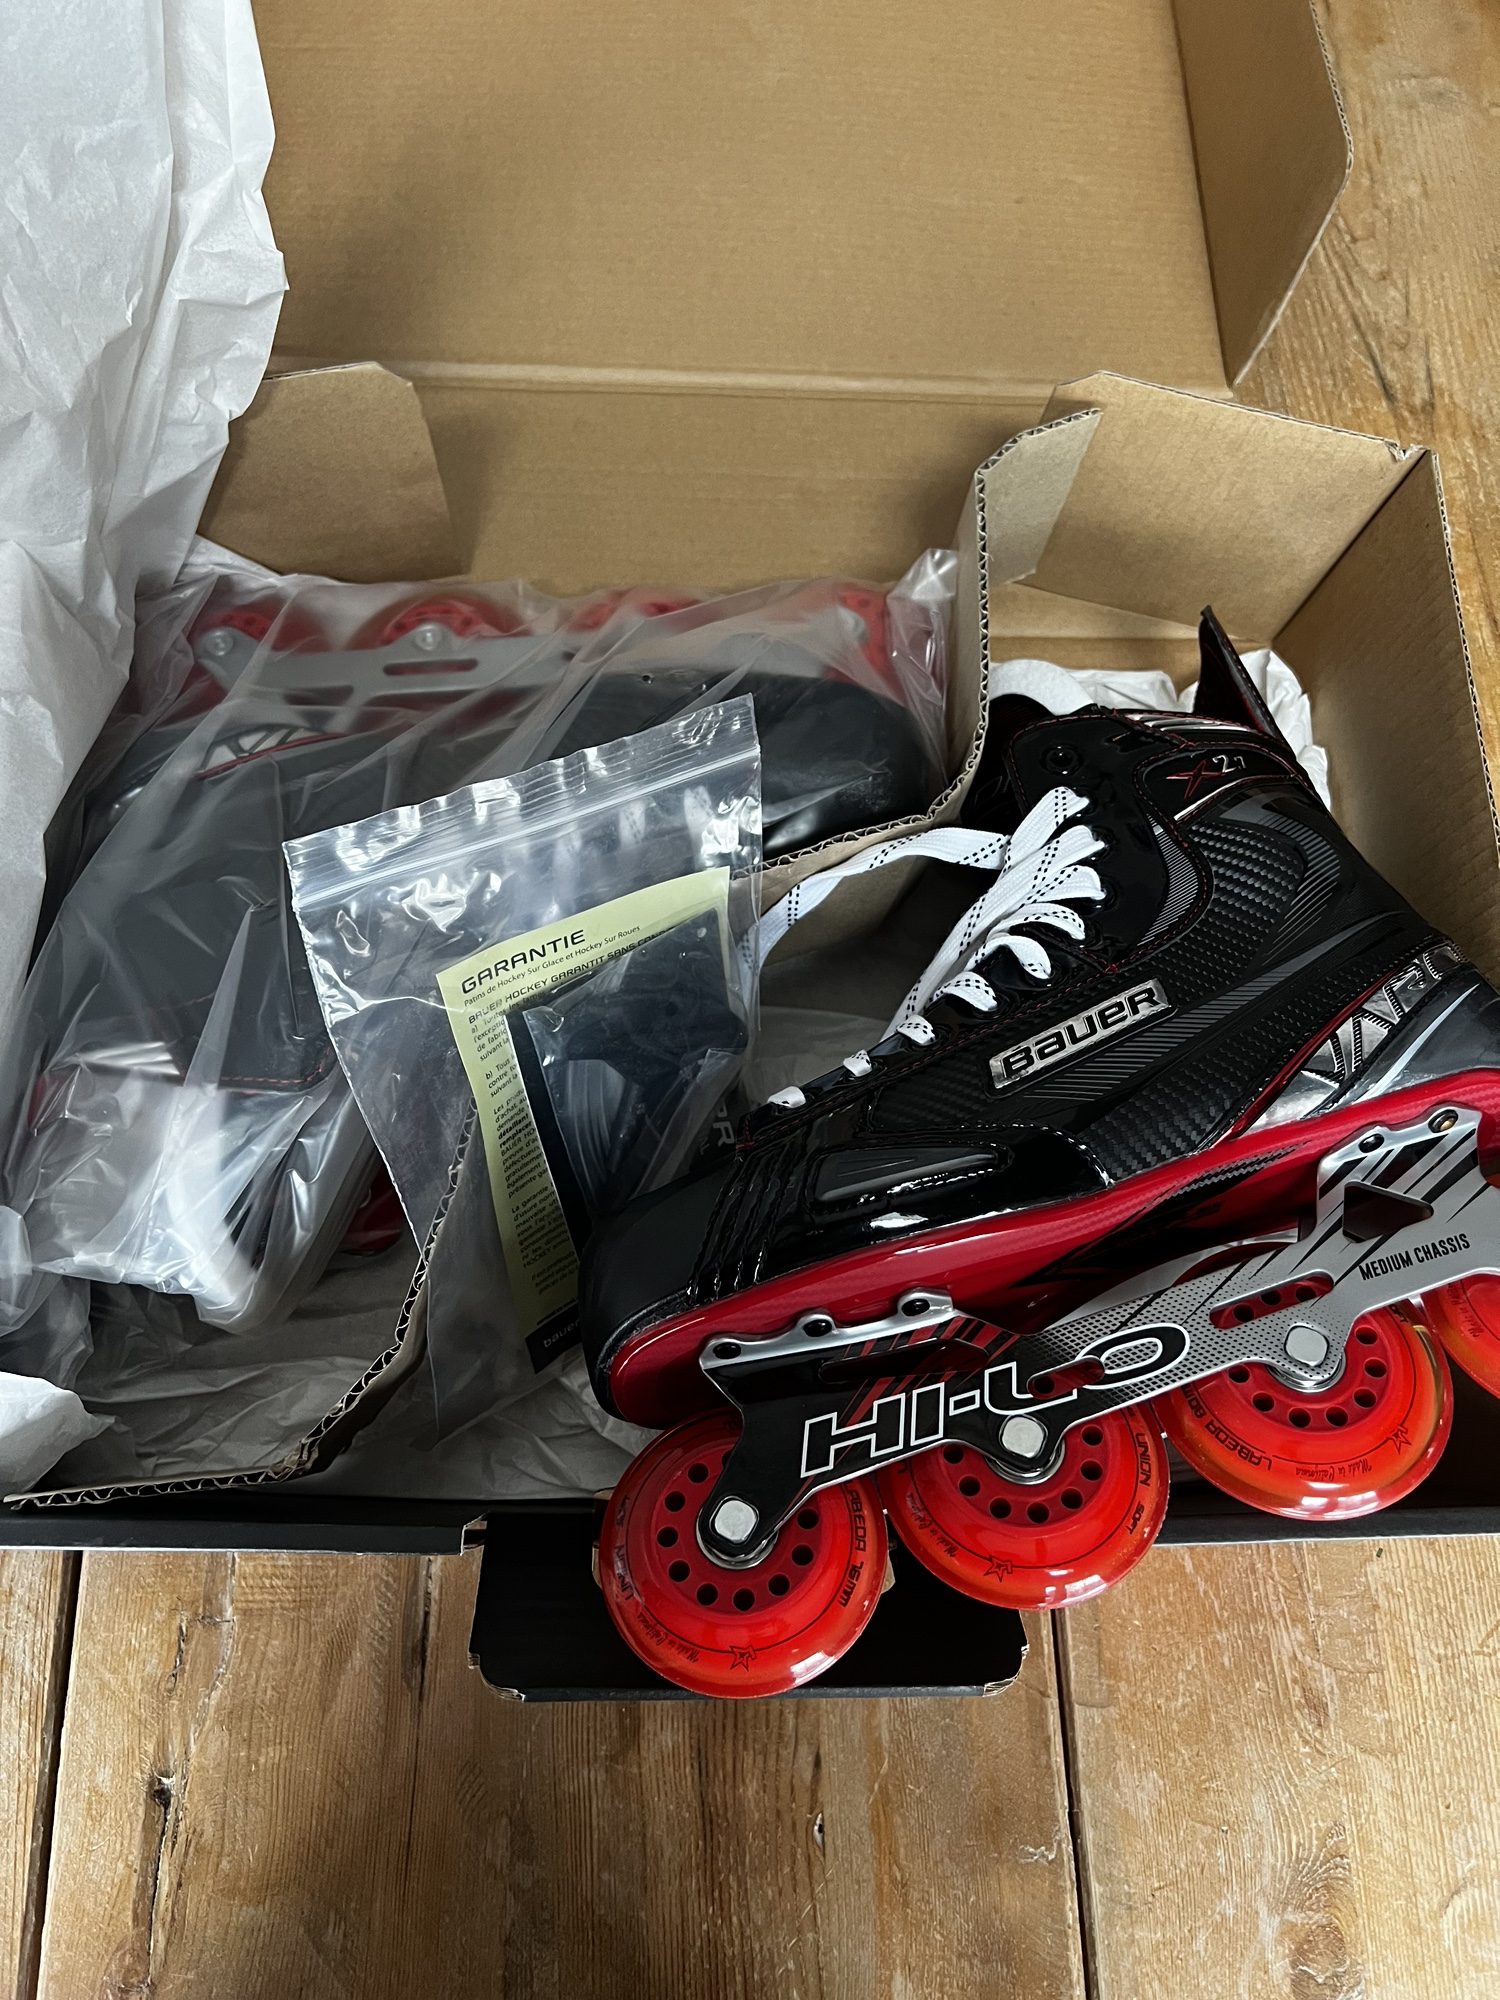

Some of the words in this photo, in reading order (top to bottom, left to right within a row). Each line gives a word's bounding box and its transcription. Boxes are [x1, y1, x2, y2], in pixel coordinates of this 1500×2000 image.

[461, 929, 586, 994] GARANTIE
[464, 992, 486, 1008] Patins
[487, 984, 497, 995] de
[497, 971, 526, 989] Hockey
[527, 965, 541, 976] Sur
[542, 955, 564, 970] Glace
[565, 952, 574, 961] et
[574, 941, 603, 957] Hockey
[604, 935, 617, 945] Sur
[618, 925, 641, 939] Roues
[468, 999, 503, 1024] BAUER
[504, 978, 549, 1003] HOCKEY
[550, 955, 605, 983] GARANTIT
[607, 943, 636, 961] SANS
[476, 1042, 486, 1053] de
[479, 1040, 503, 1062] suivant
[485, 1070, 493, 1080] b)
[495, 1058, 511, 1072] Tous
[488, 1070, 508, 1089] contre
[490, 1078, 512, 1098] suivant
[493, 1103, 505, 1115] Les
[496, 1105, 525, 1132] demande
[498, 1113, 529, 1140] détaillant
[499, 1120, 533, 1149] remplacer
[501, 1136, 522, 1157] BAUER
[523, 1127, 537, 1139] HO
[502, 1145, 524, 1167] preuve
[511, 1204, 520, 1214] La
[1358, 1250, 1414, 1281] MEDIUM
[1413, 1233, 1471, 1263] CHASSIS
[800, 1322, 1191, 1479] HI-LO
[1204, 1413, 1274, 1472] LABEDA
[1135, 1432, 1152, 1487] UNION
[843, 1480, 867, 1553] LABEDA
[1126, 1500, 1145, 1535] SOFT
